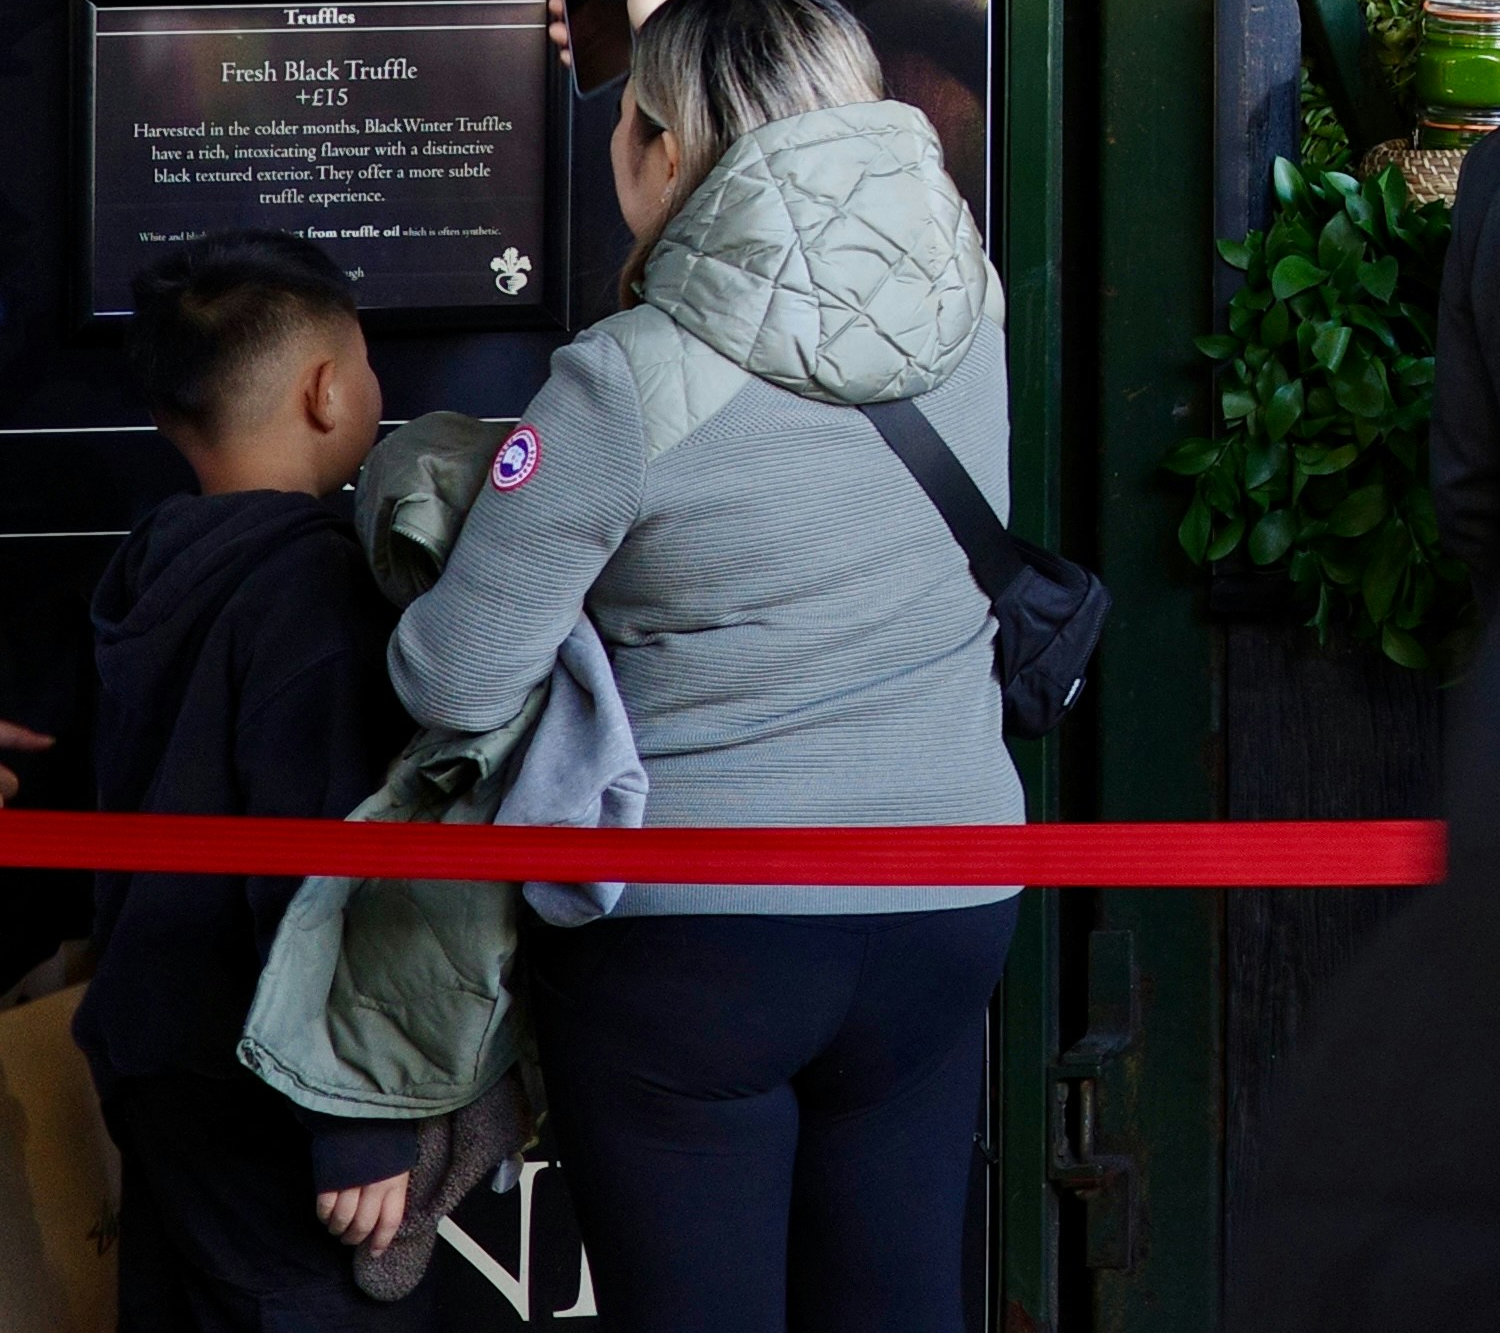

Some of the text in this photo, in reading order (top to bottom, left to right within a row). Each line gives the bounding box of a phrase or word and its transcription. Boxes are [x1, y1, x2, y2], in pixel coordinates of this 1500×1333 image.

[283, 7, 356, 25] Truffles
[221, 57, 418, 82] Fresh Black Truffle
[295, 88, 348, 107] +£15
[133, 121, 206, 138] Harvested
[210, 122, 224, 136] in
[228, 120, 251, 136] the
[254, 119, 299, 136] colder
[302, 118, 360, 135] months,
[455, 115, 513, 132] Truffles
[151, 140, 494, 163] have a rich, intoxicating flavour with a distinctive
[154, 162, 491, 185] black textured exterior. They offer a more subtle
[259, 188, 386, 208] truffle experience.
[139, 232, 184, 242] White and
[307, 226, 338, 239] from
[340, 225, 380, 238] truffle
[382, 224, 400, 237] oil
[402, 226, 427, 237] which
[437, 226, 461, 236] often
[462, 225, 502, 237] synthetic.
